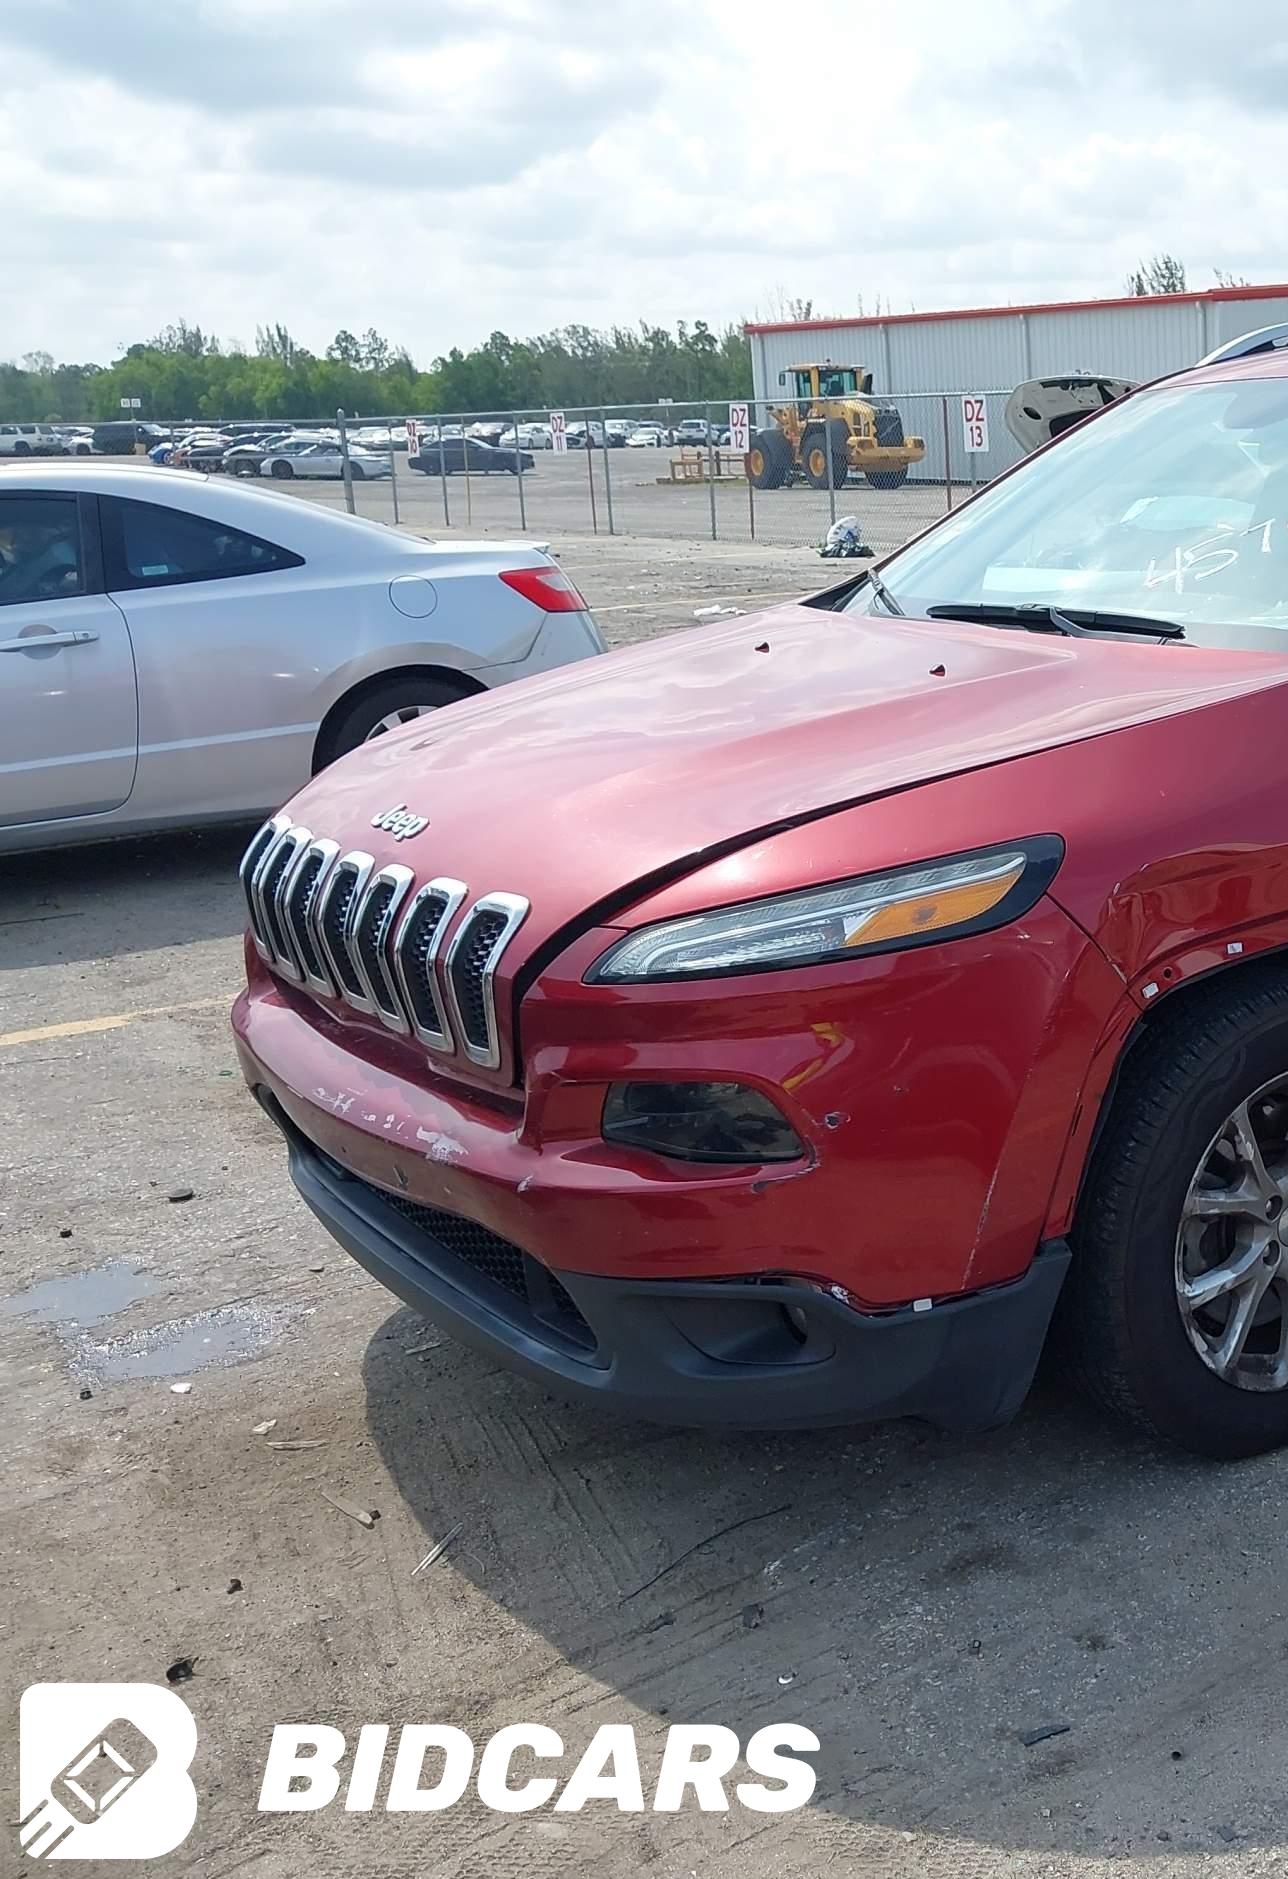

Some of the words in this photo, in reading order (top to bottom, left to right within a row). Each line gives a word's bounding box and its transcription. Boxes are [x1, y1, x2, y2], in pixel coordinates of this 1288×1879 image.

[731, 407, 747, 428] DZ
[964, 399, 985, 422] DZ
[734, 430, 745, 449] 12
[969, 425, 984, 448] 13
[370, 802, 430, 843] Jeep
